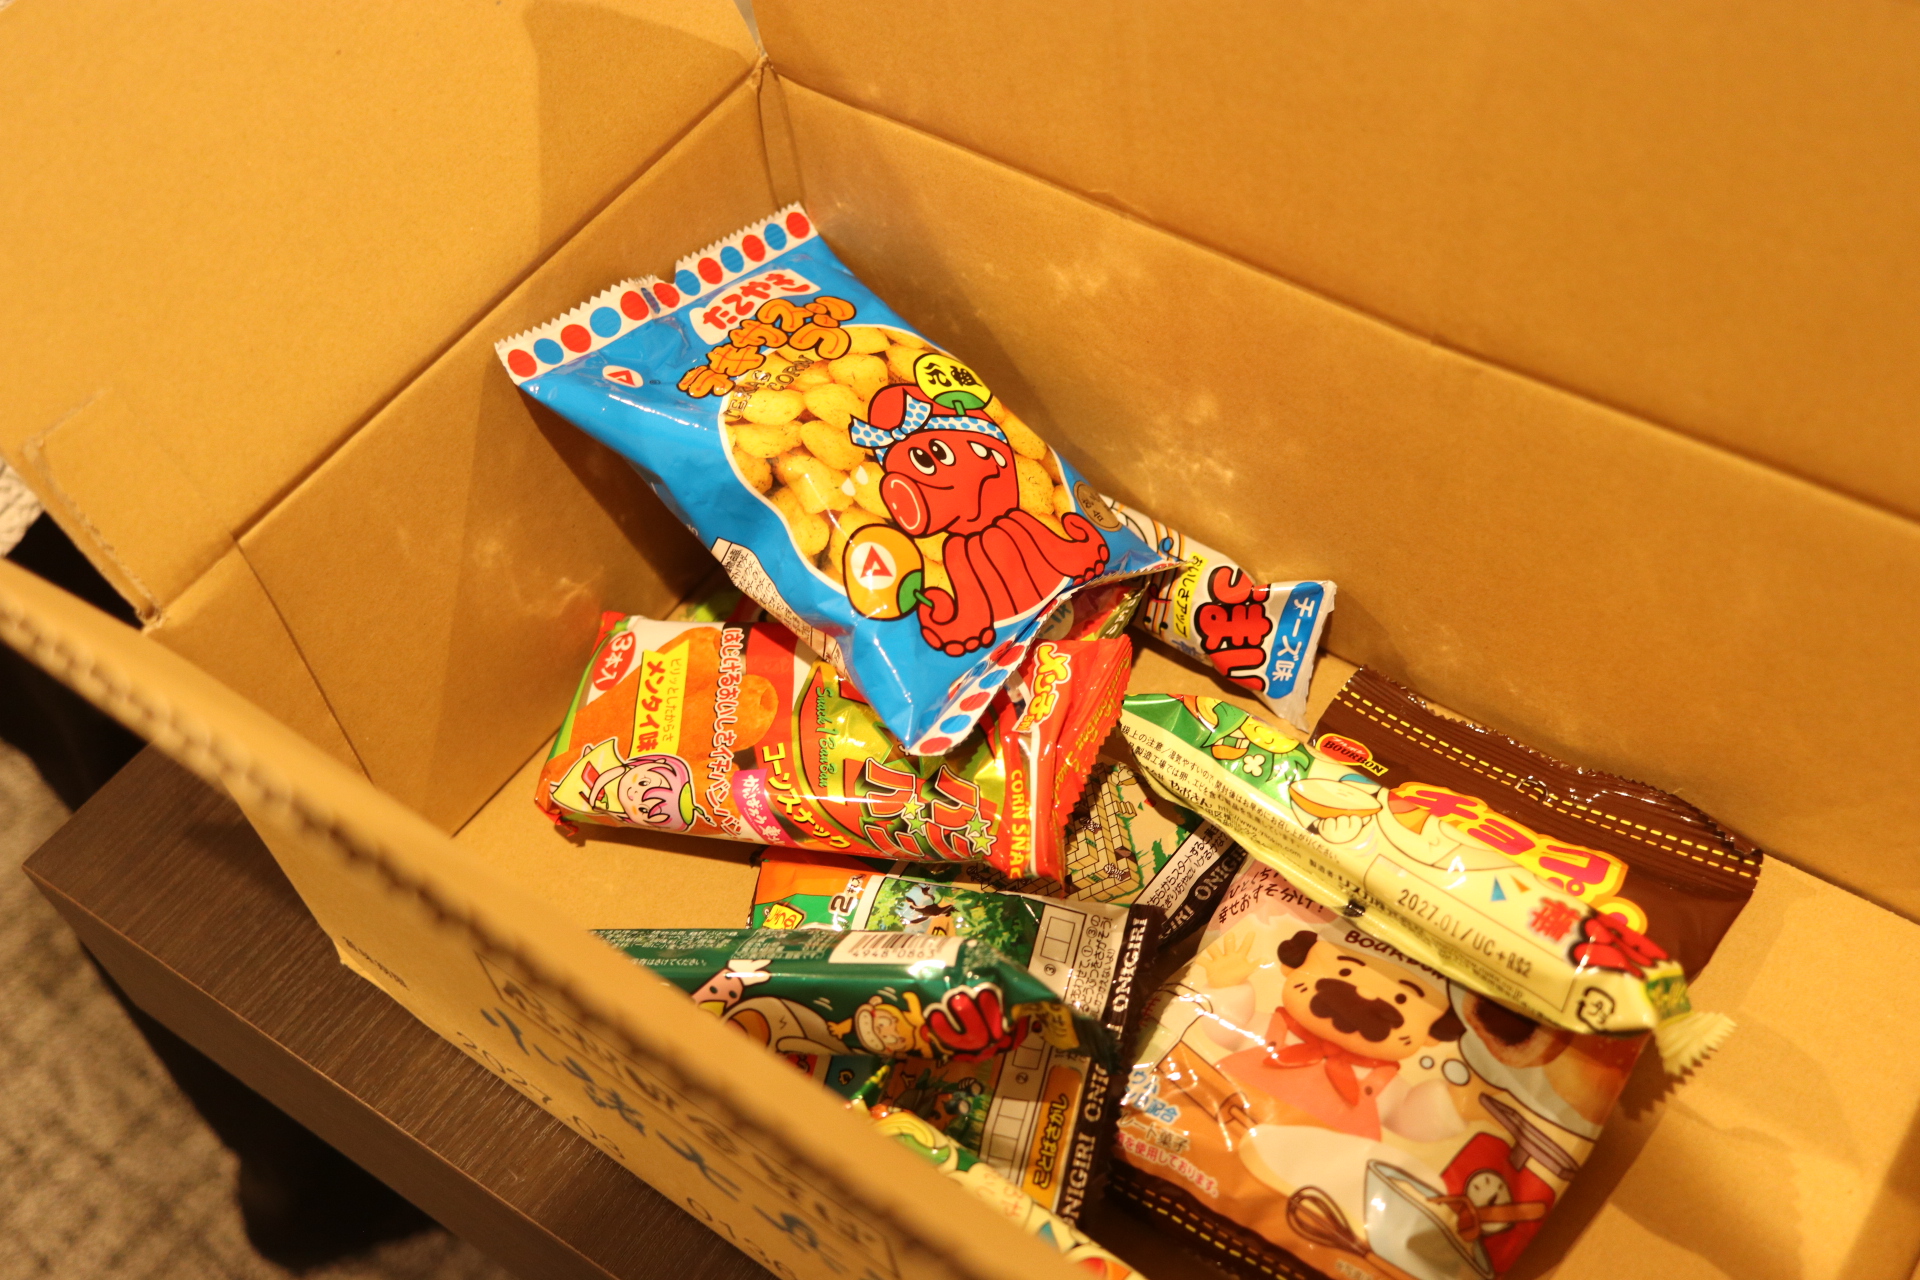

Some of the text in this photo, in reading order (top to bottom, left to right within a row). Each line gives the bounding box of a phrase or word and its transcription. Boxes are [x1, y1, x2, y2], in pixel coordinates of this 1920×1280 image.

[703, 273, 811, 330] たこやき
[677, 296, 857, 398] テキサスコーン
[768, 354, 815, 392] CORN
[722, 369, 773, 421] TEXAS
[1175, 555, 1203, 638] おいしさアップ
[594, 635, 633, 686] 3本入
[1273, 597, 1316, 682] チーズ味
[636, 658, 667, 753] メンタイ味
[661, 657, 683, 743] ピリッとしたからさ
[815, 686, 834, 723] Snack
[762, 742, 852, 850] コーンスナック
[1010, 769, 1023, 818] CORN
[1119, 722, 1340, 865] 扱上の注意/湿気やすいので、開封後はお早めにお召し上がりください。
[1322, 740, 1384, 775] BOURBON
[1229, 867, 1288, 899] ひとくち
[1112, 917, 1148, 1015] ONIGIRI
[480, 1006, 880, 1280] 小諸七兵
[1034, 1094, 1068, 1189] ことばさがし
